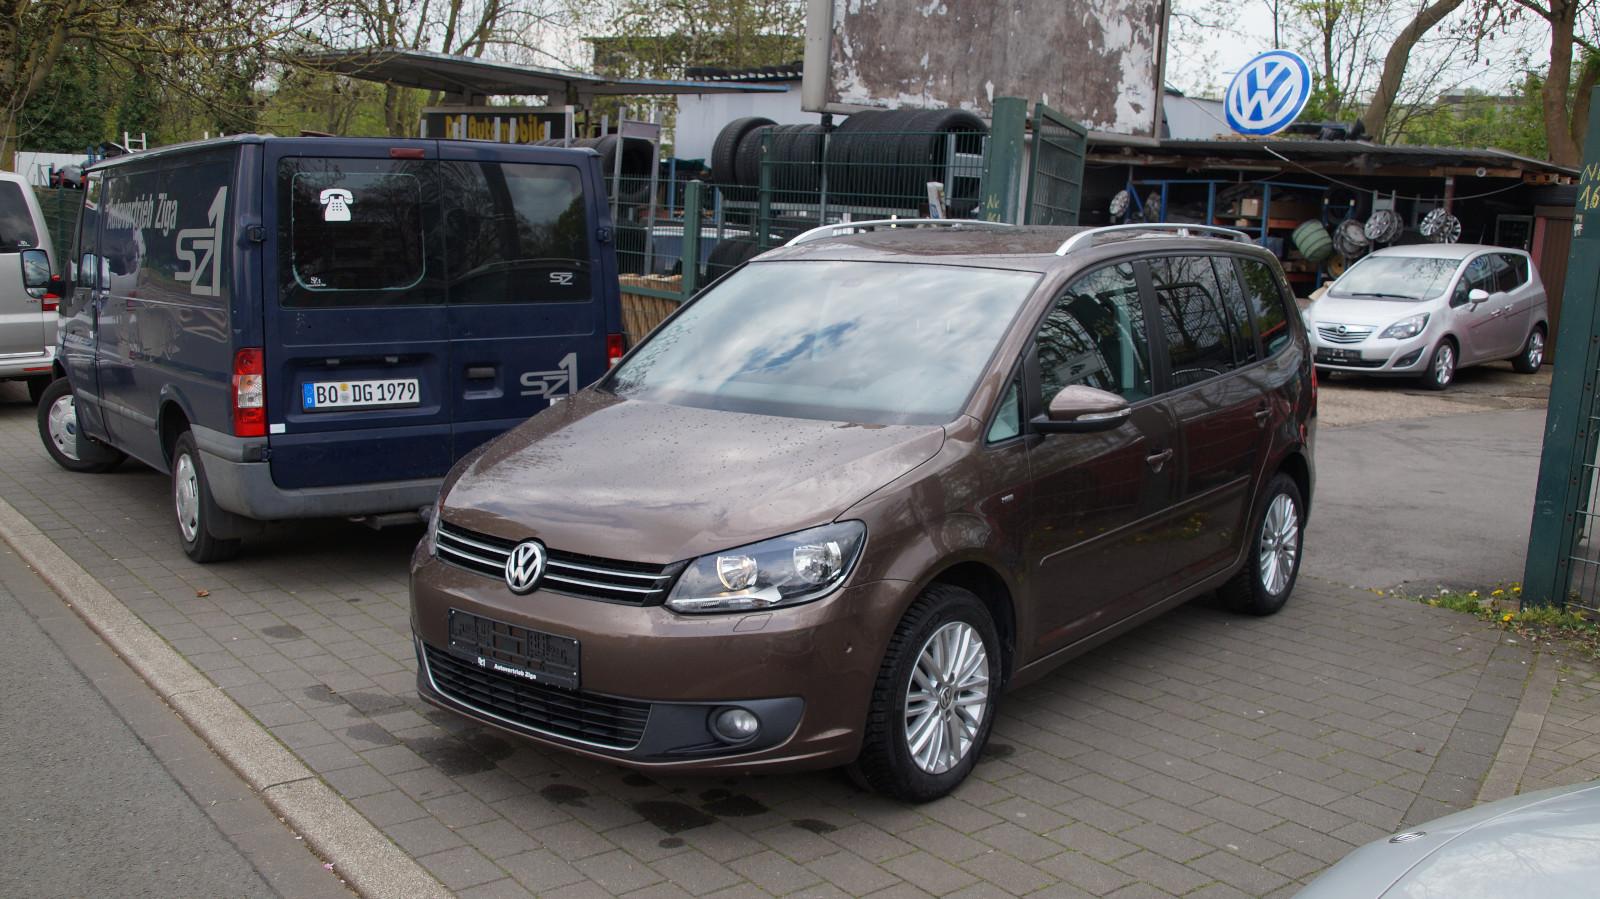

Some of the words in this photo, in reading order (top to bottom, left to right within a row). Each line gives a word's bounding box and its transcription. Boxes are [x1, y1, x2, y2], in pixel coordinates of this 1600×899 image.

[1229, 56, 1301, 128] VW
[1580, 162, 1600, 184] N
[106, 193, 154, 230] Autovertrieb
[154, 192, 178, 237] Ziga
[316, 385, 338, 404] BO
[351, 383, 373, 403] DG
[377, 382, 416, 401] 1979
[508, 543, 540, 589] VW
[494, 663, 525, 676] Autovertrieb
[524, 671, 537, 680] Ziga
